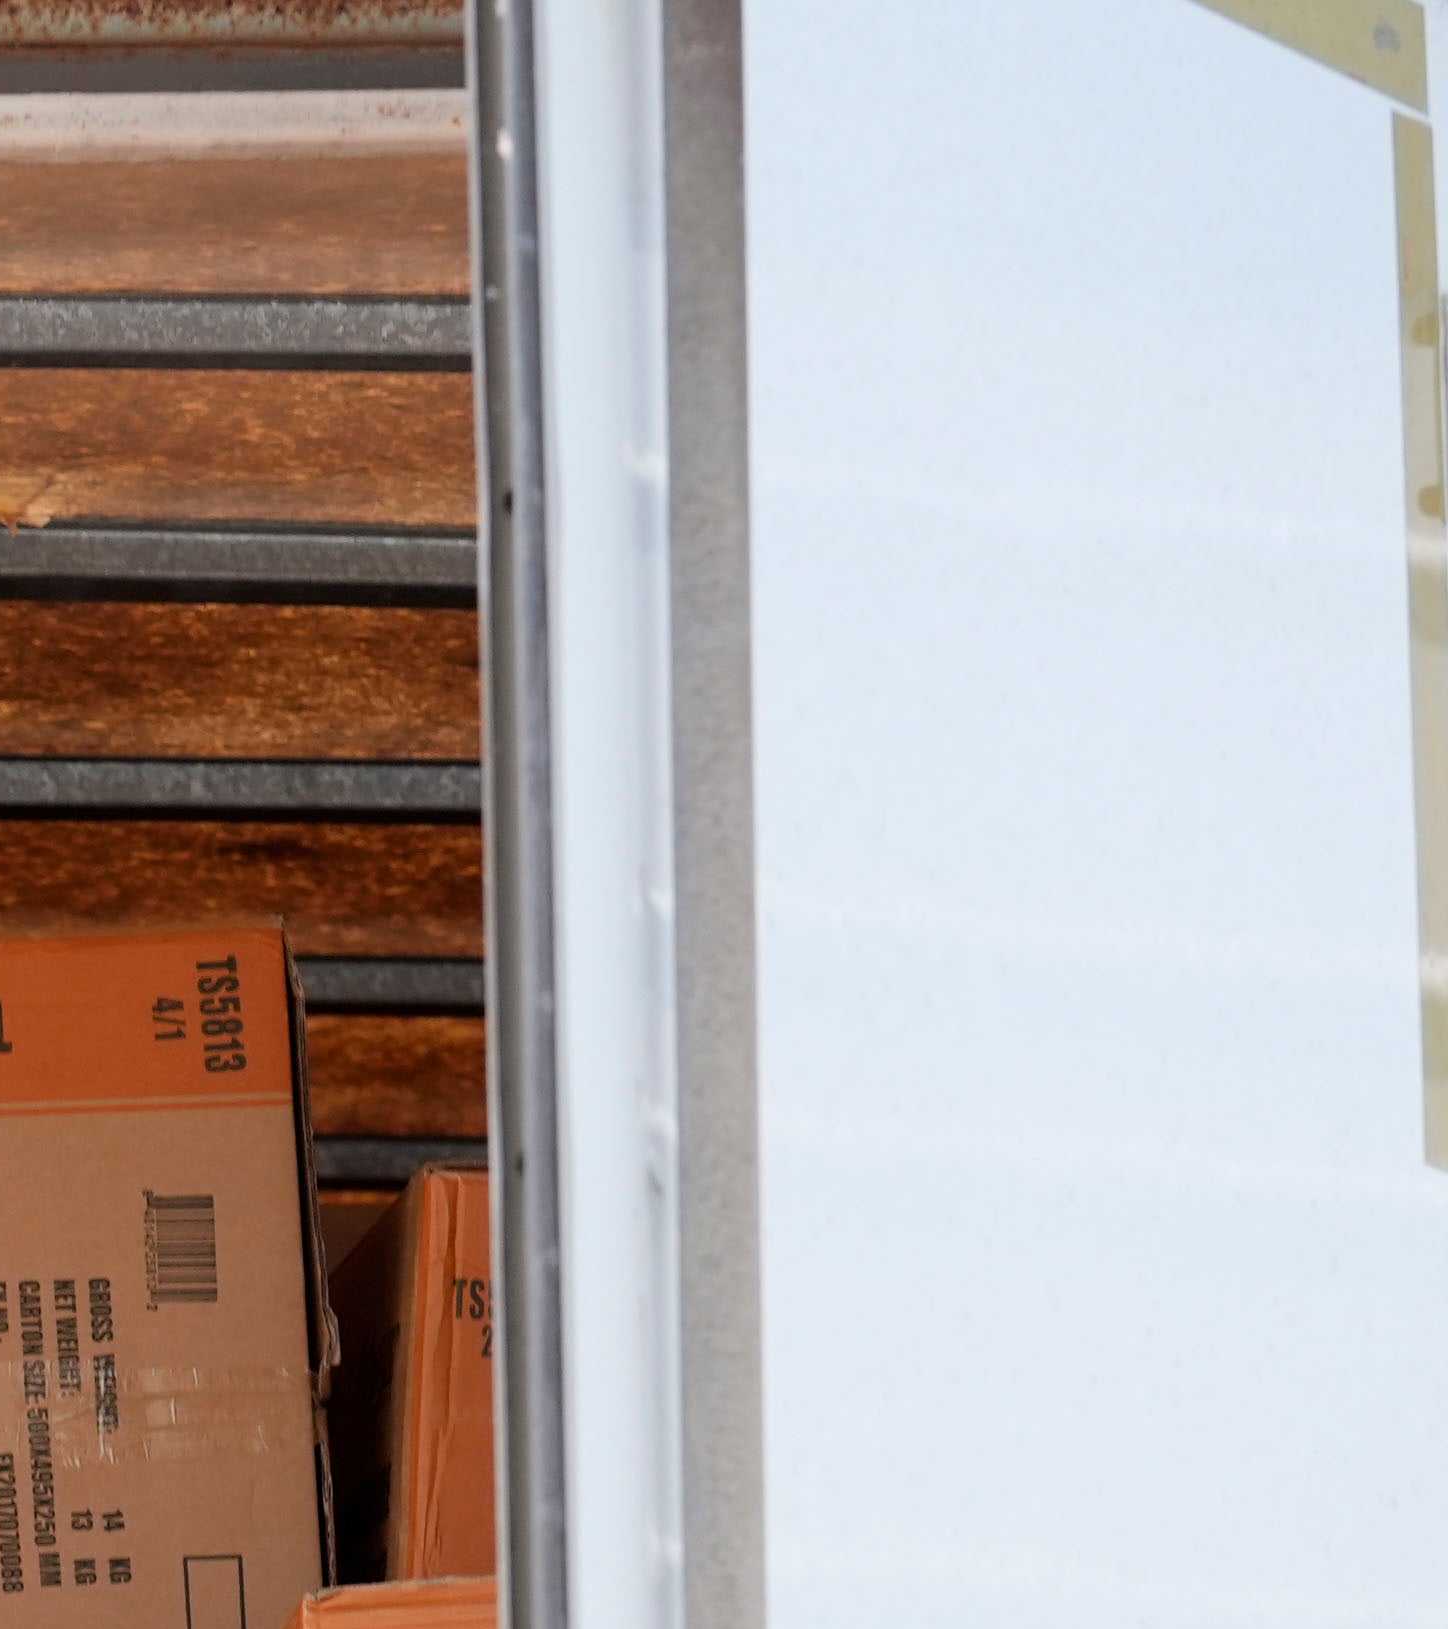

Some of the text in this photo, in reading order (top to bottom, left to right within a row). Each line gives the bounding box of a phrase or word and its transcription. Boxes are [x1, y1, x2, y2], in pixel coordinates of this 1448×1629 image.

[152, 998, 186, 1040] 4/1
[196, 956, 246, 1072] TS5813
[54, 1280, 76, 1313] NET
[89, 1278, 113, 1342] GROSS
[449, 1275, 490, 1319] TS
[19, 1281, 43, 1355] CARTON
[39, 1552, 61, 1586] MM
[71, 1510, 93, 1530] 13
[102, 1510, 125, 1532] 14
[74, 1559, 96, 1585] KG
[109, 1558, 132, 1583] KG
